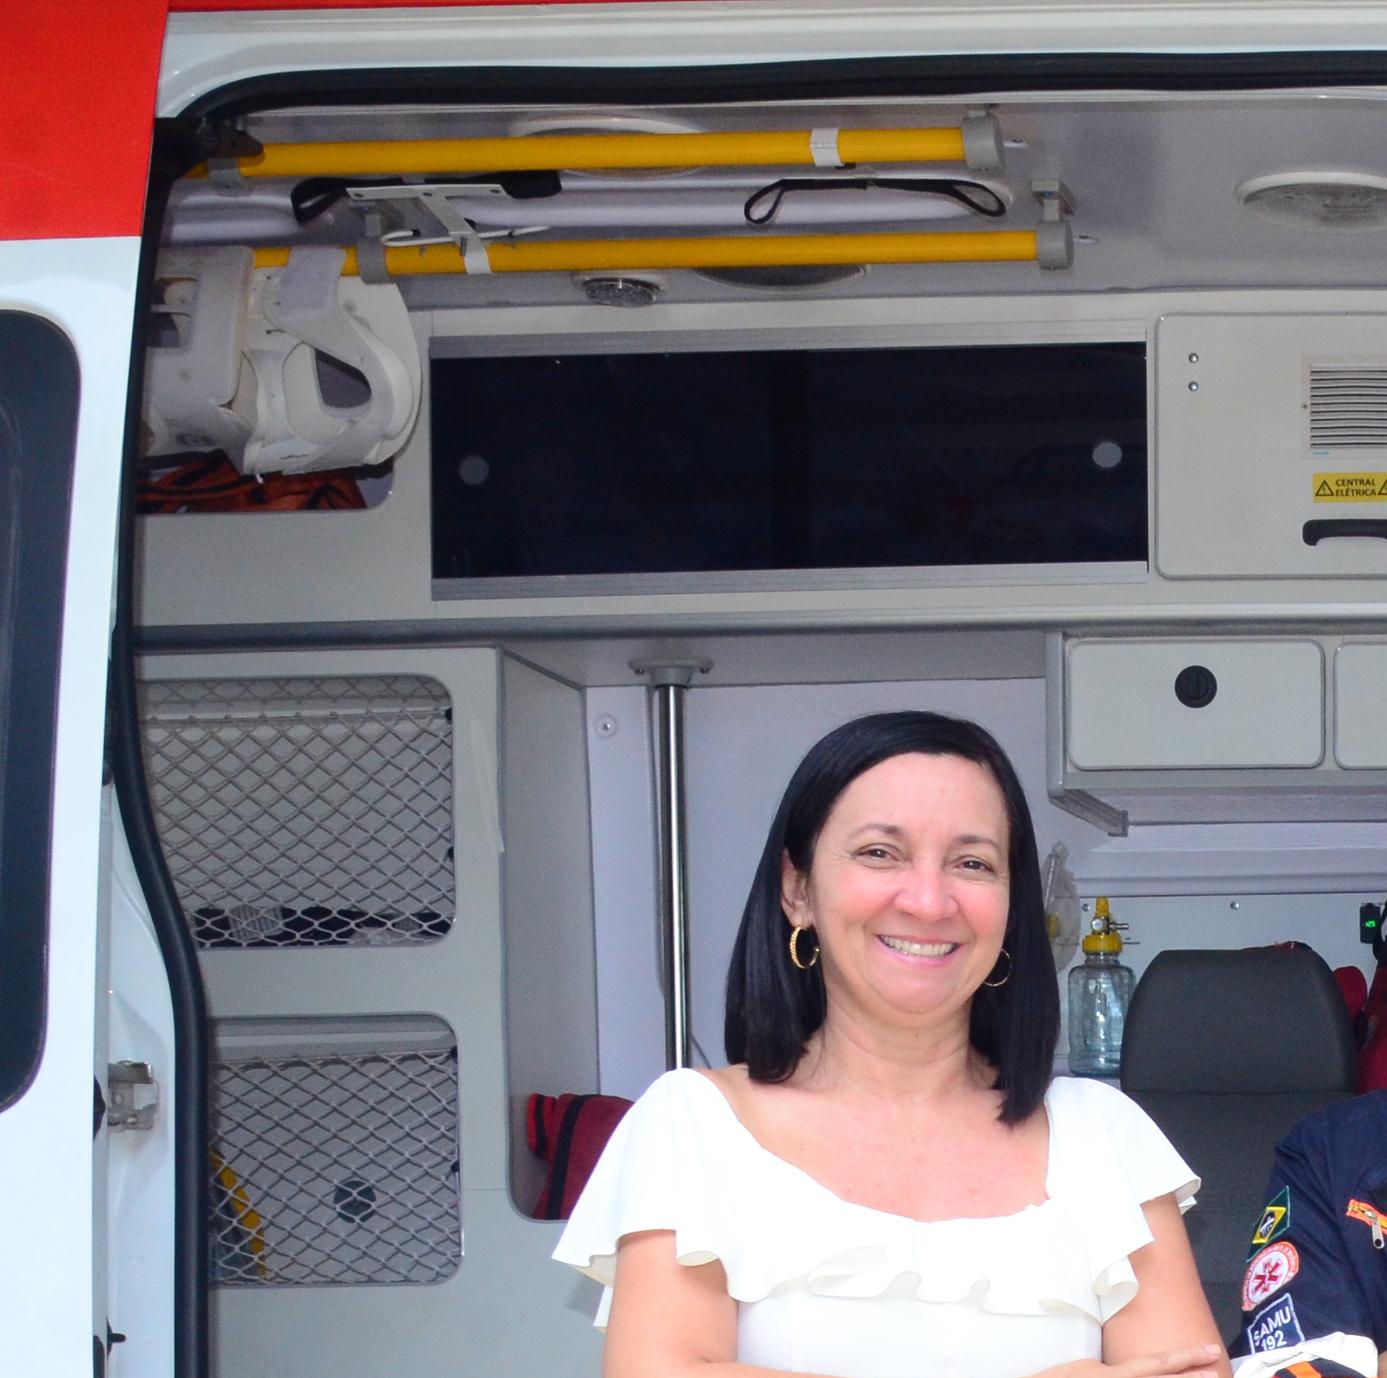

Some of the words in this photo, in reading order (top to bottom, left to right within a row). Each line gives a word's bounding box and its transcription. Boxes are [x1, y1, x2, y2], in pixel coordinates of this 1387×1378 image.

[1335, 478, 1376, 487] CENTRAL
[1335, 488, 1377, 497] ELÉTRICA
[1254, 1306, 1292, 1346] SAMU
[1261, 1330, 1288, 1352] 192
